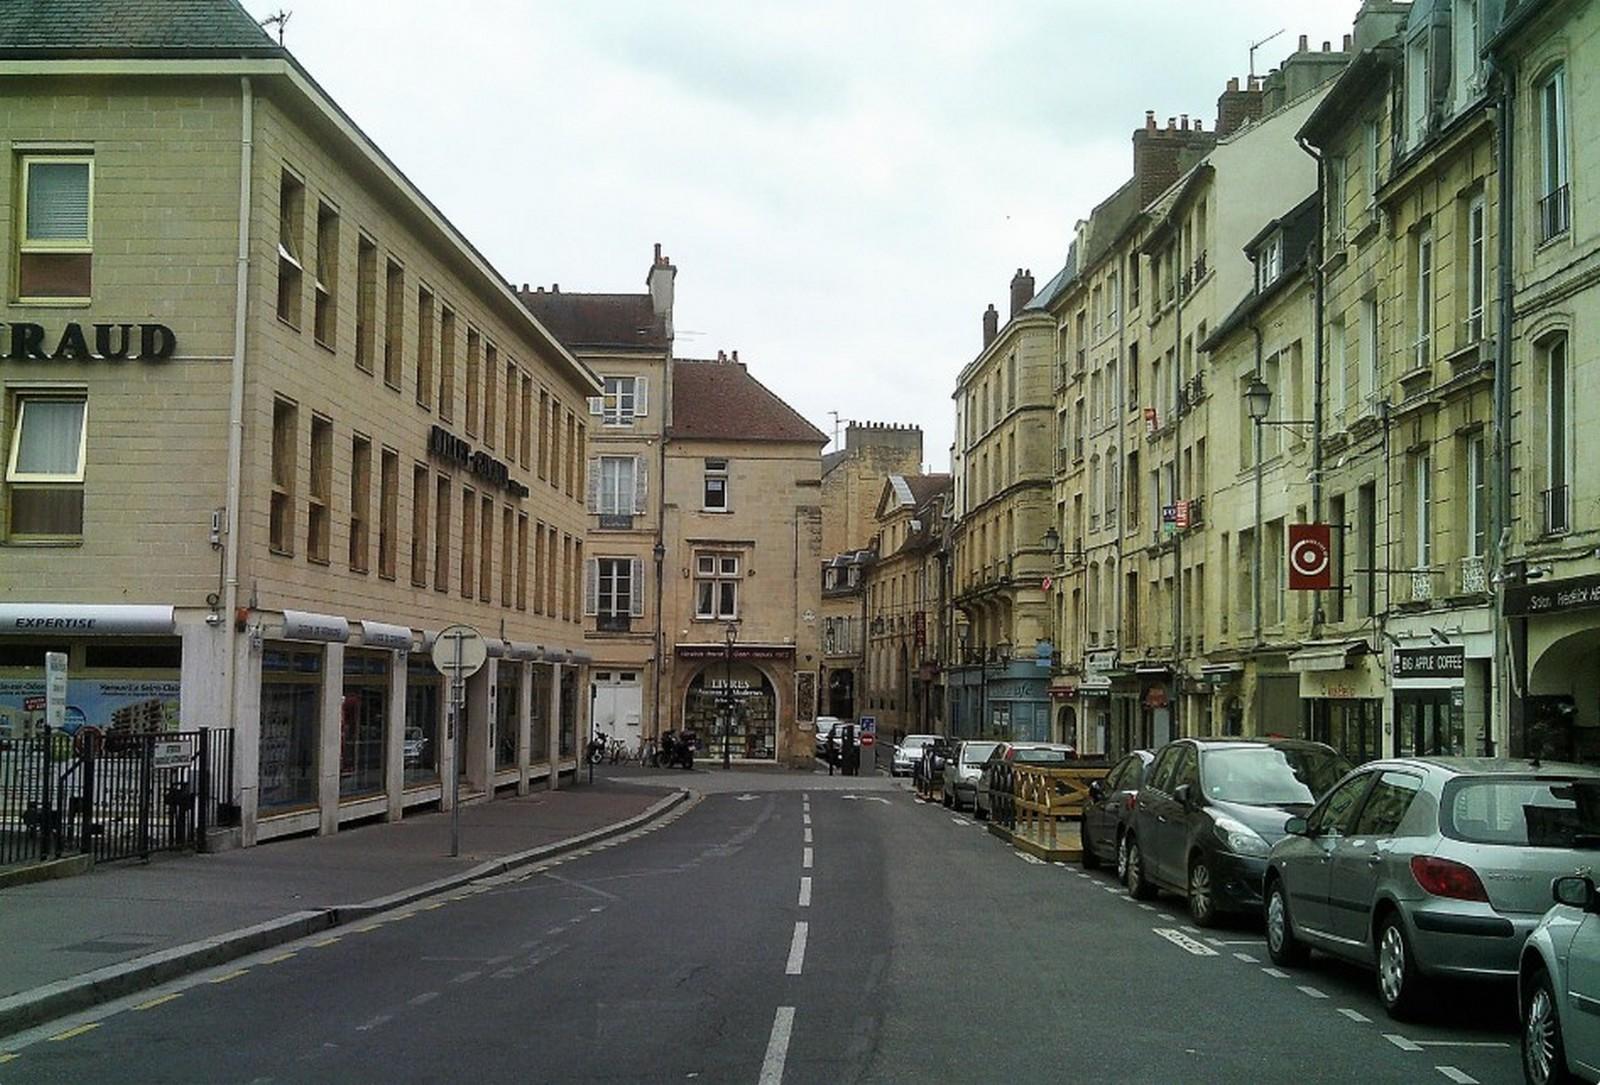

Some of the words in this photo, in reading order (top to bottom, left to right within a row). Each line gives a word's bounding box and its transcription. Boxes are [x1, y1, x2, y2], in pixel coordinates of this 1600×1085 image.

[15, 618, 96, 628] EXPERTISE
[1402, 656, 1413, 670] BIG
[1415, 656, 1434, 670] APPLE
[1437, 655, 1462, 669] COFFEE
[712, 679, 750, 689] LIVRES
